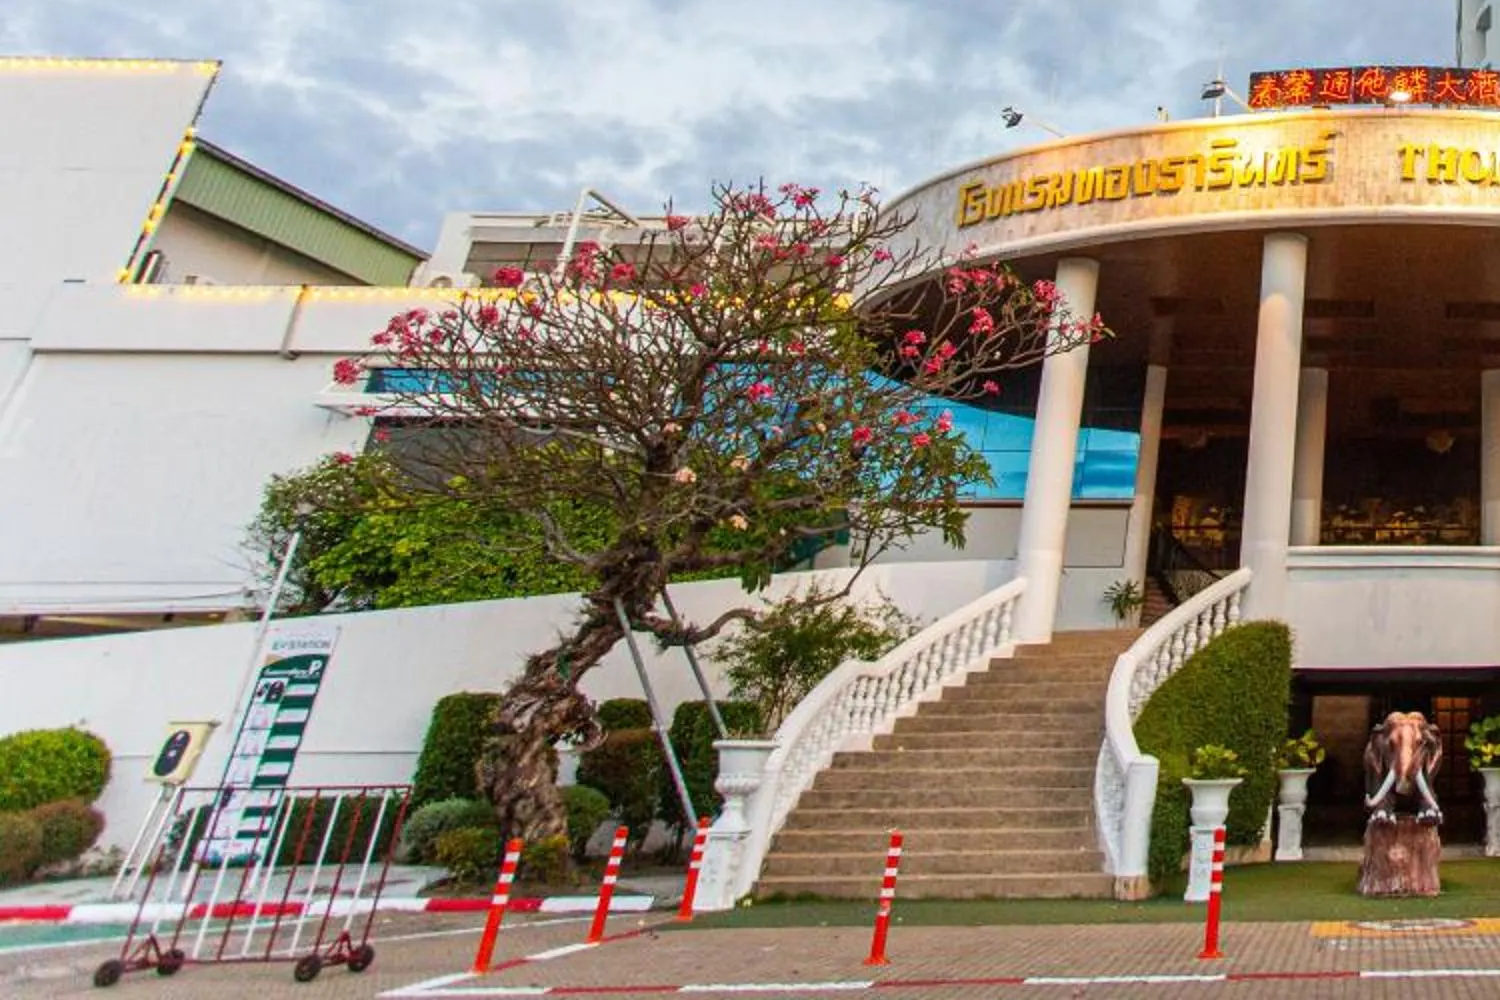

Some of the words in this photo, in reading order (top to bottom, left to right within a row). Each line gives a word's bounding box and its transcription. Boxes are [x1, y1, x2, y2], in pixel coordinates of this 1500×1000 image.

[957, 132, 1336, 228] โรงแรมทองธารินทร์
